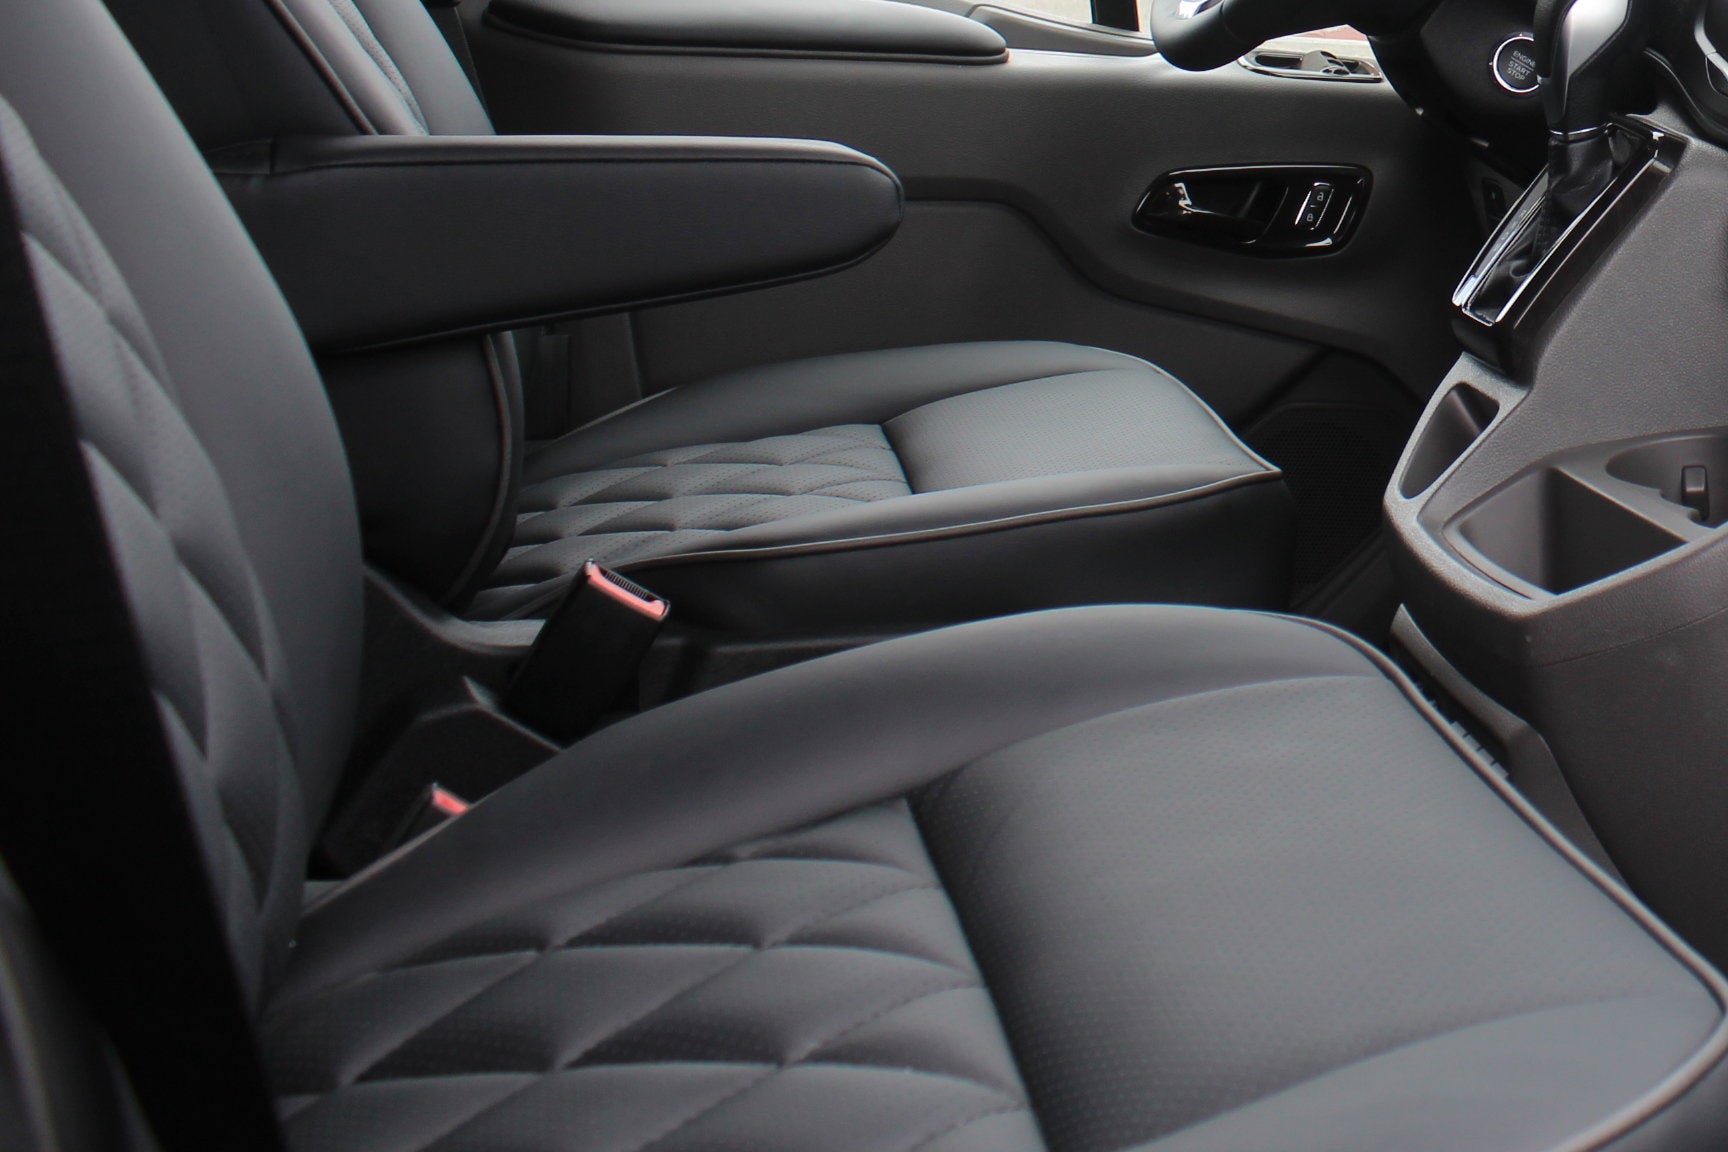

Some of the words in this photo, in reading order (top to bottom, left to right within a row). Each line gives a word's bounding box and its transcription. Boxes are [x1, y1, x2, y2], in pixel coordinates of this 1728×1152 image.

[1513, 50, 1536, 68] ENGINE
[1507, 68, 1525, 80] STOP
[1509, 60, 1530, 76] START
